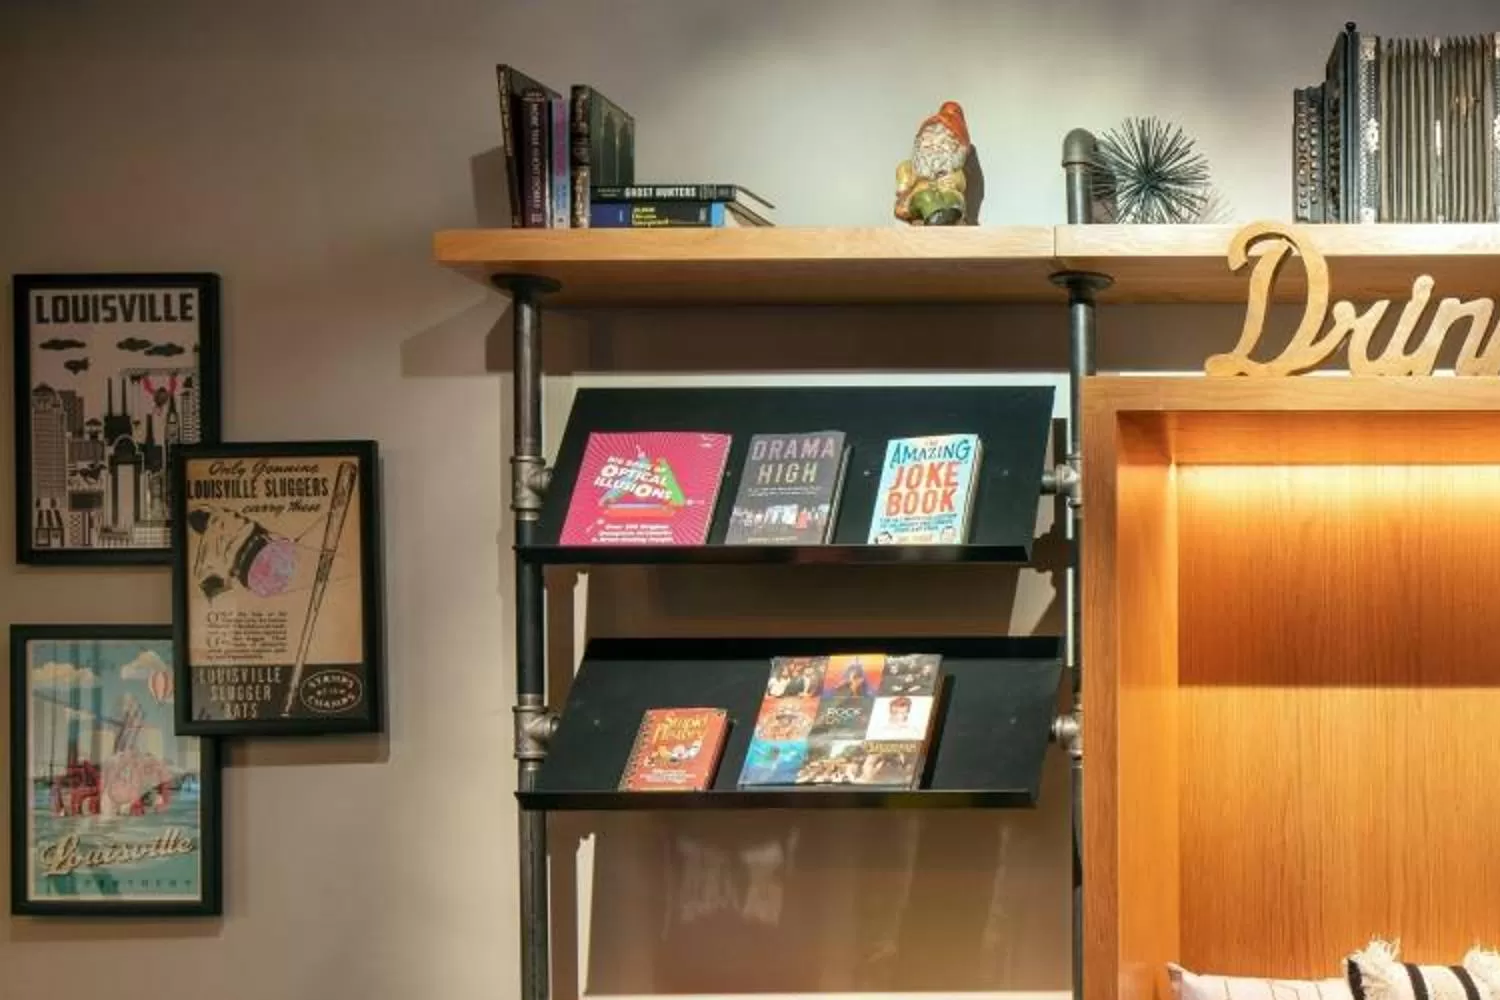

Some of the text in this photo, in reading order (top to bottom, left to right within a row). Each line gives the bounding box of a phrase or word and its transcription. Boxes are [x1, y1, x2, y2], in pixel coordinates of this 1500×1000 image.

[35, 293, 196, 325] LOUISVILLE
[752, 437, 836, 461] DRAMA
[889, 438, 972, 468] AMAZING
[601, 463, 669, 487] OPTICAL
[757, 461, 819, 485] HIGH
[888, 462, 962, 490] JOKE
[187, 477, 329, 499] LOUISVILLE SLUGGERS
[593, 476, 674, 500] ILLUSIONS
[885, 489, 957, 516] BOOK
[199, 667, 283, 684] LOUISVILLE
[211, 685, 272, 701] SLUGGER
[40, 827, 195, 877] Louisville
